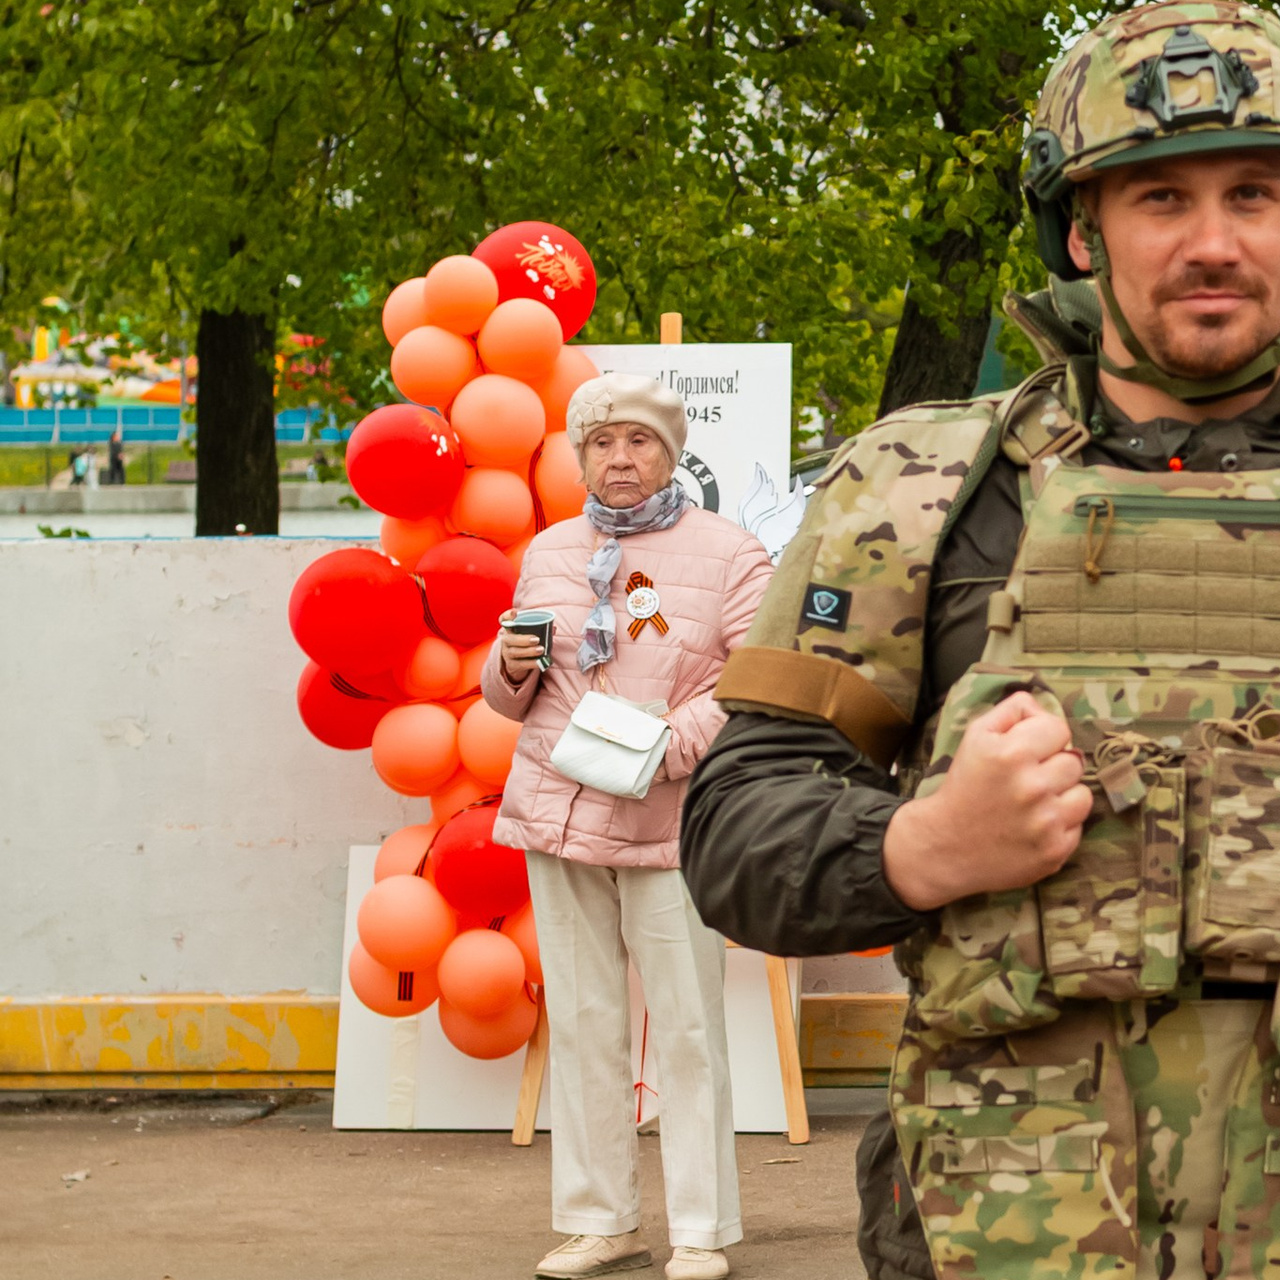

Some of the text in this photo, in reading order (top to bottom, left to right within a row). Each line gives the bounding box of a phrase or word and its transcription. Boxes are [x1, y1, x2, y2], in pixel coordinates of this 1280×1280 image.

[668, 369, 740, 401] Гордимся!
[686, 405, 722, 423] 945
[679, 451, 715, 487] КАЯ
